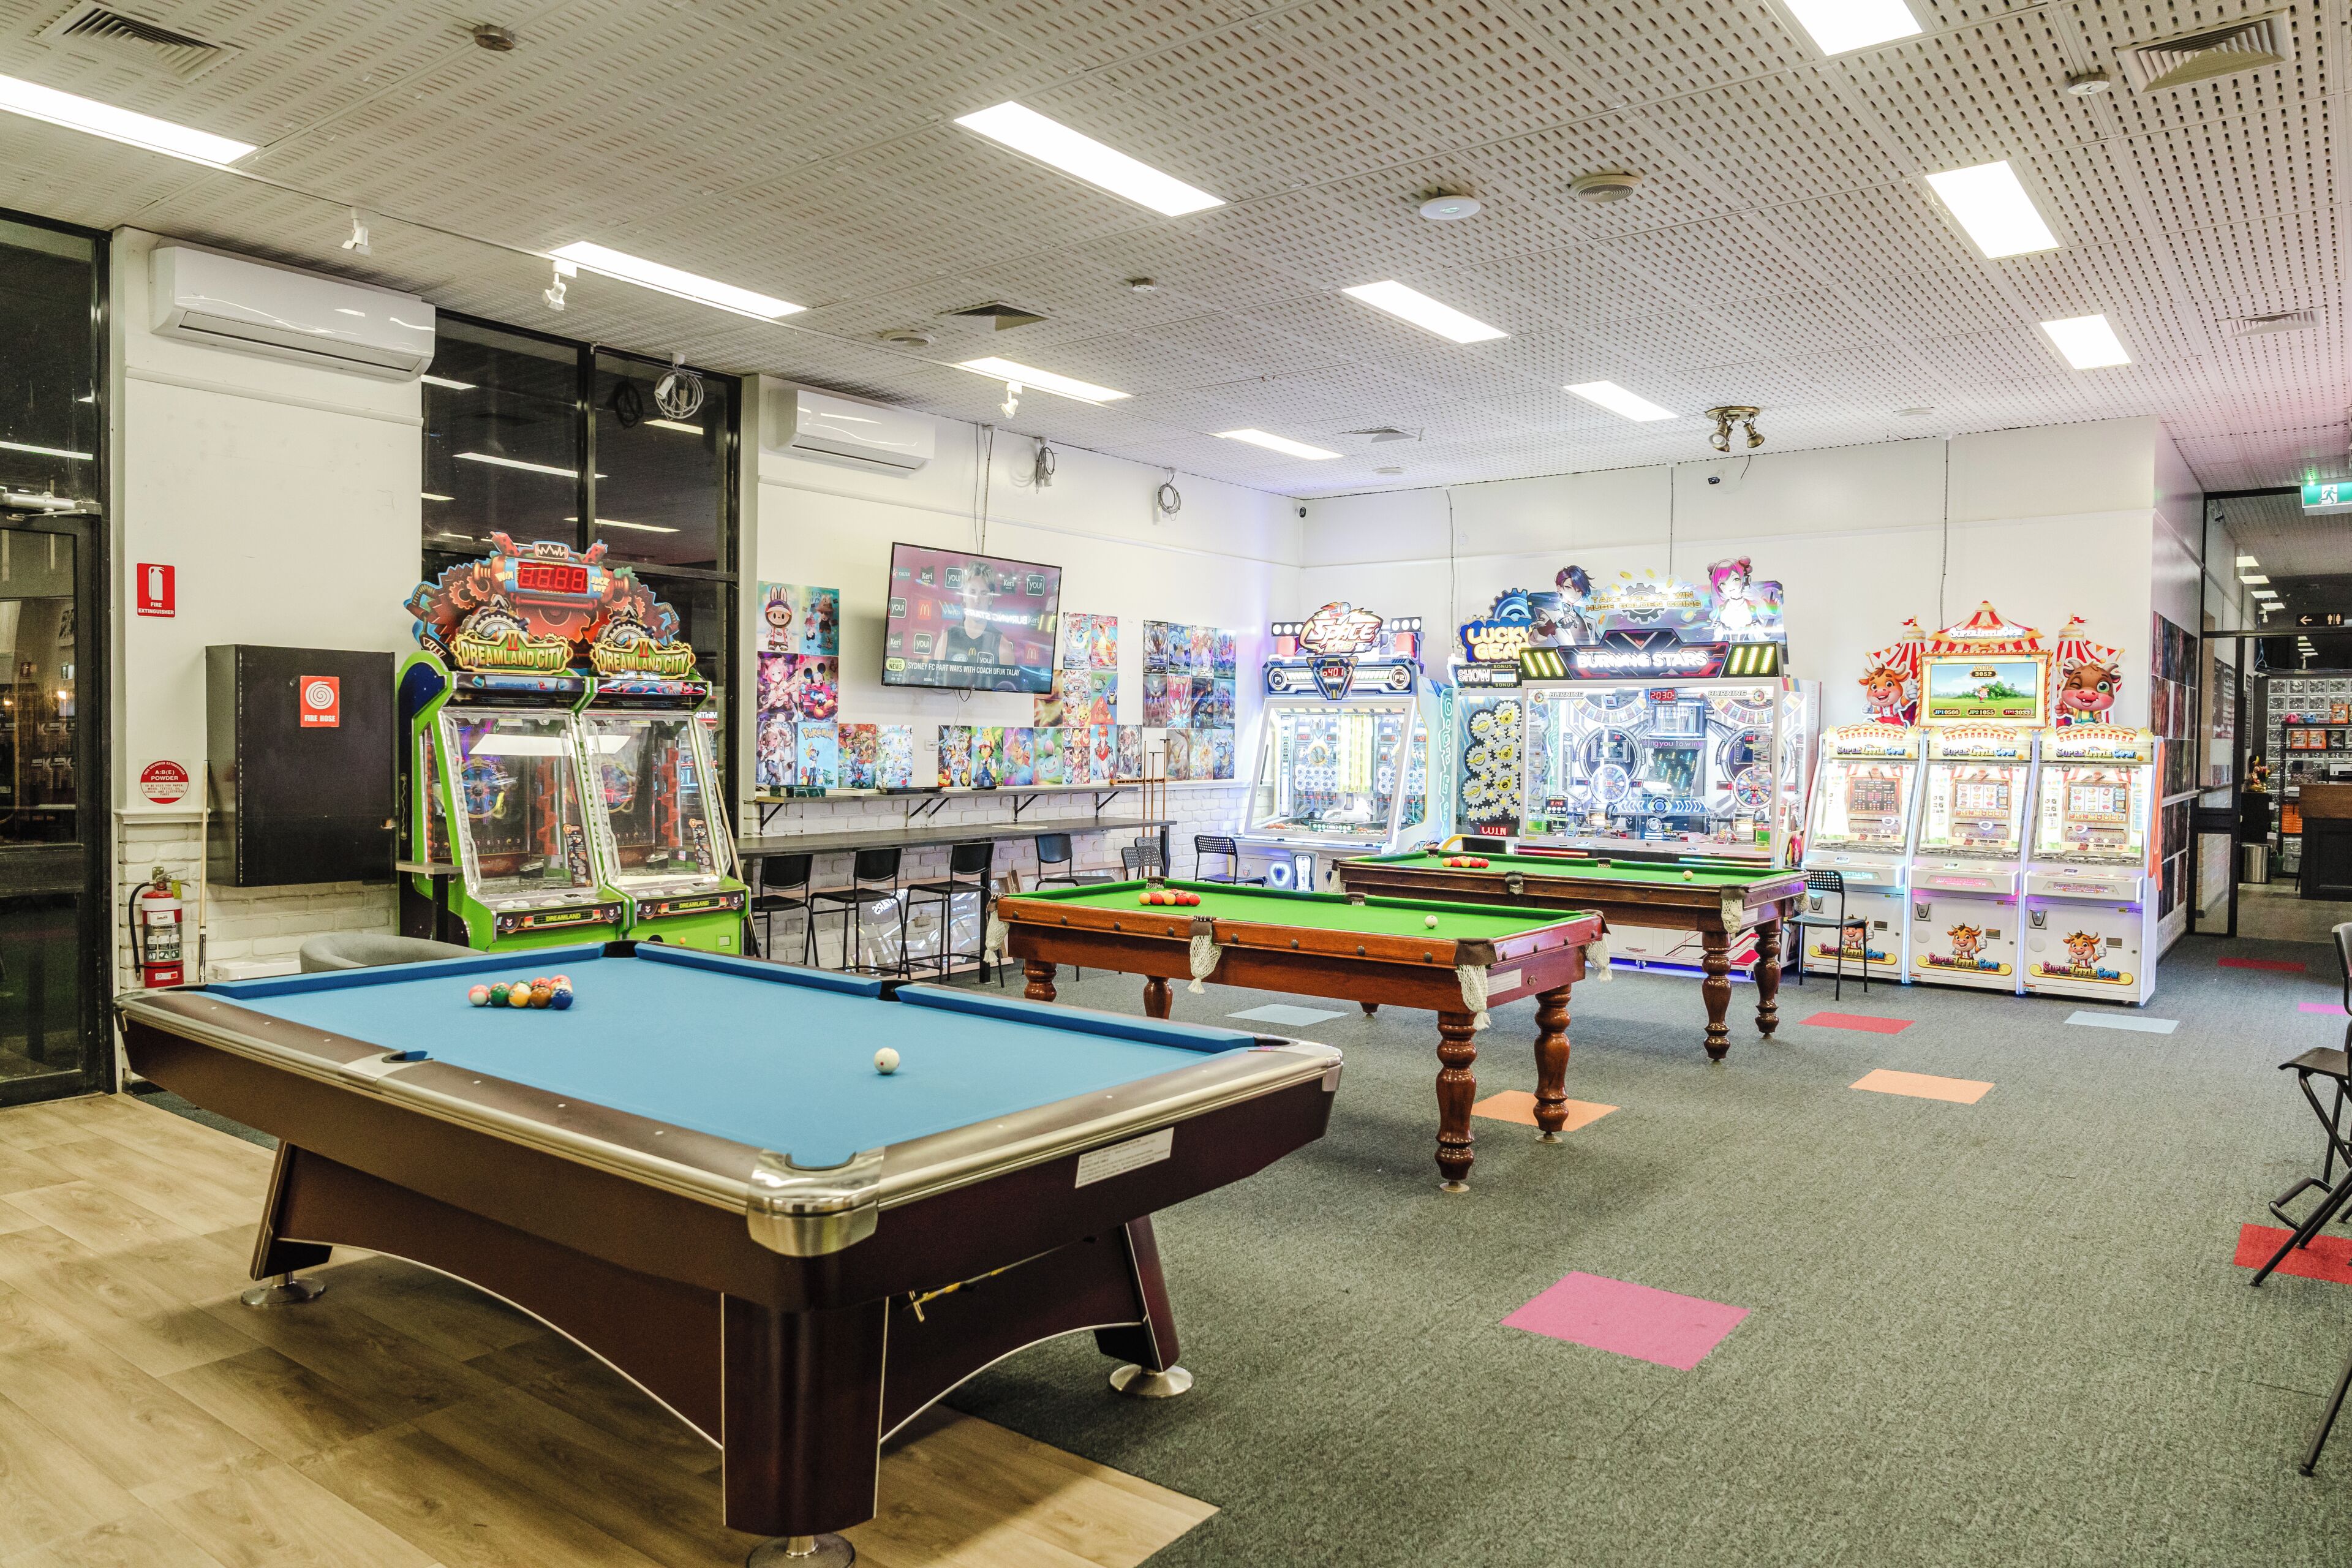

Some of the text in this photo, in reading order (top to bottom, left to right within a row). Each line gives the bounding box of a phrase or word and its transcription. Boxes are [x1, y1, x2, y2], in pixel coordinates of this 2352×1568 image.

[590, 576, 611, 586] JACK
[948, 572, 961, 584] youi
[1030, 579, 1042, 591] youi
[891, 601, 905, 613] youi
[1306, 619, 1376, 643] SPACE
[1467, 626, 1532, 644] LUCKY
[916, 638, 930, 650] youi
[461, 641, 564, 669] DREAMLAND CITY
[1576, 650, 1708, 668] BURNING STARS
[598, 649, 688, 674] DREAMLAND CITY
[1457, 669, 1491, 682] SHOW
[1837, 745, 1861, 754] SUPER
[1942, 747, 2017, 757] SUPER LITTLE COW
[2056, 748, 2137, 759] SUPER LITTLE COW
[679, 900, 709, 909] DREAMLAND
[545, 913, 581, 922] DREAMLAND
[1820, 942, 1886, 960] SUPE LITTL COW
[1928, 952, 2000, 971] SUPER LITTLE COW
[2042, 960, 2120, 980] SUPER LITTLE COW
